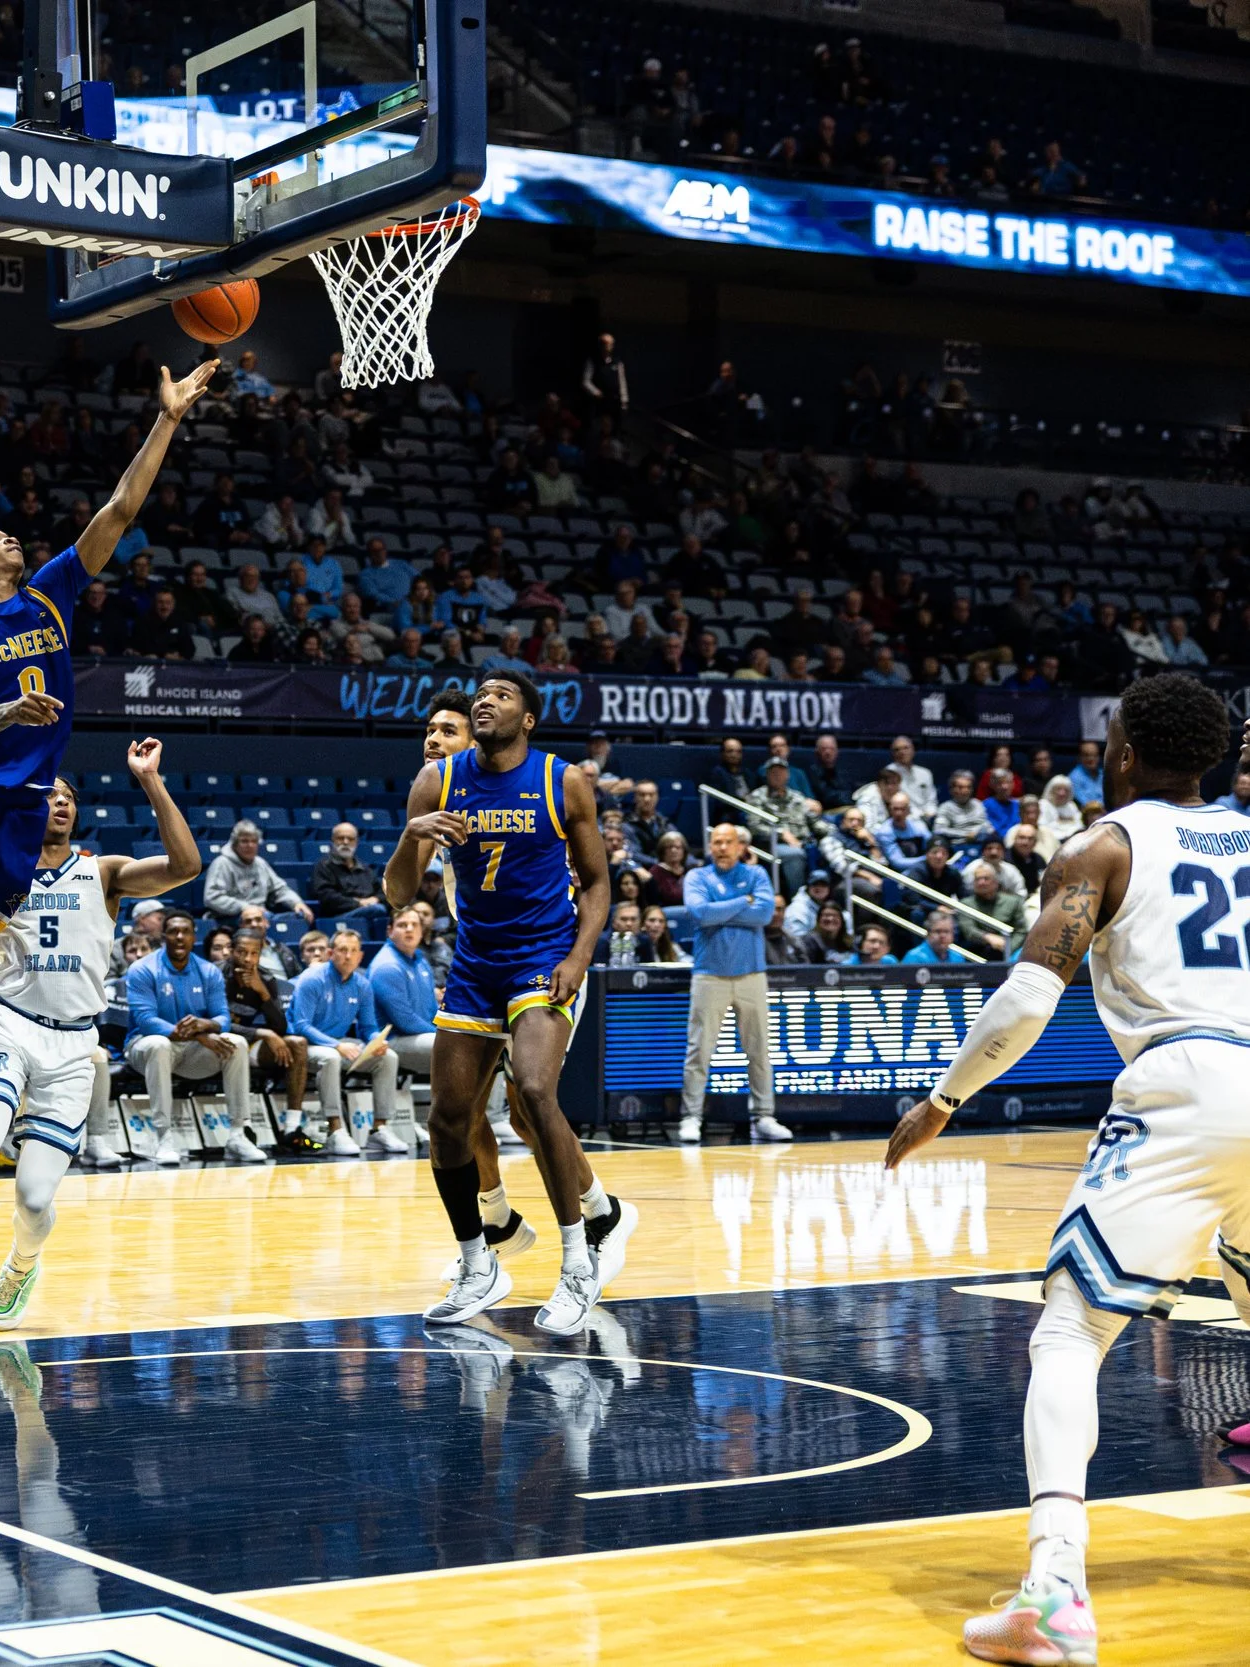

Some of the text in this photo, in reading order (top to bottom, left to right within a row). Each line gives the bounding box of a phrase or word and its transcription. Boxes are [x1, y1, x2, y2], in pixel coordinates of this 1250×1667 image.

[874, 203, 1175, 276] RAISE THE ROOF
[156, 687, 243, 700] RHODE ISLAND
[340, 671, 477, 720] WELC
[600, 685, 712, 725] RHODY
[723, 688, 843, 728] NATION
[124, 704, 243, 717] MEDICAL IMAGING
[479, 841, 506, 891] 7
[39, 915, 59, 948] 5
[24, 954, 82, 973] SLAND
